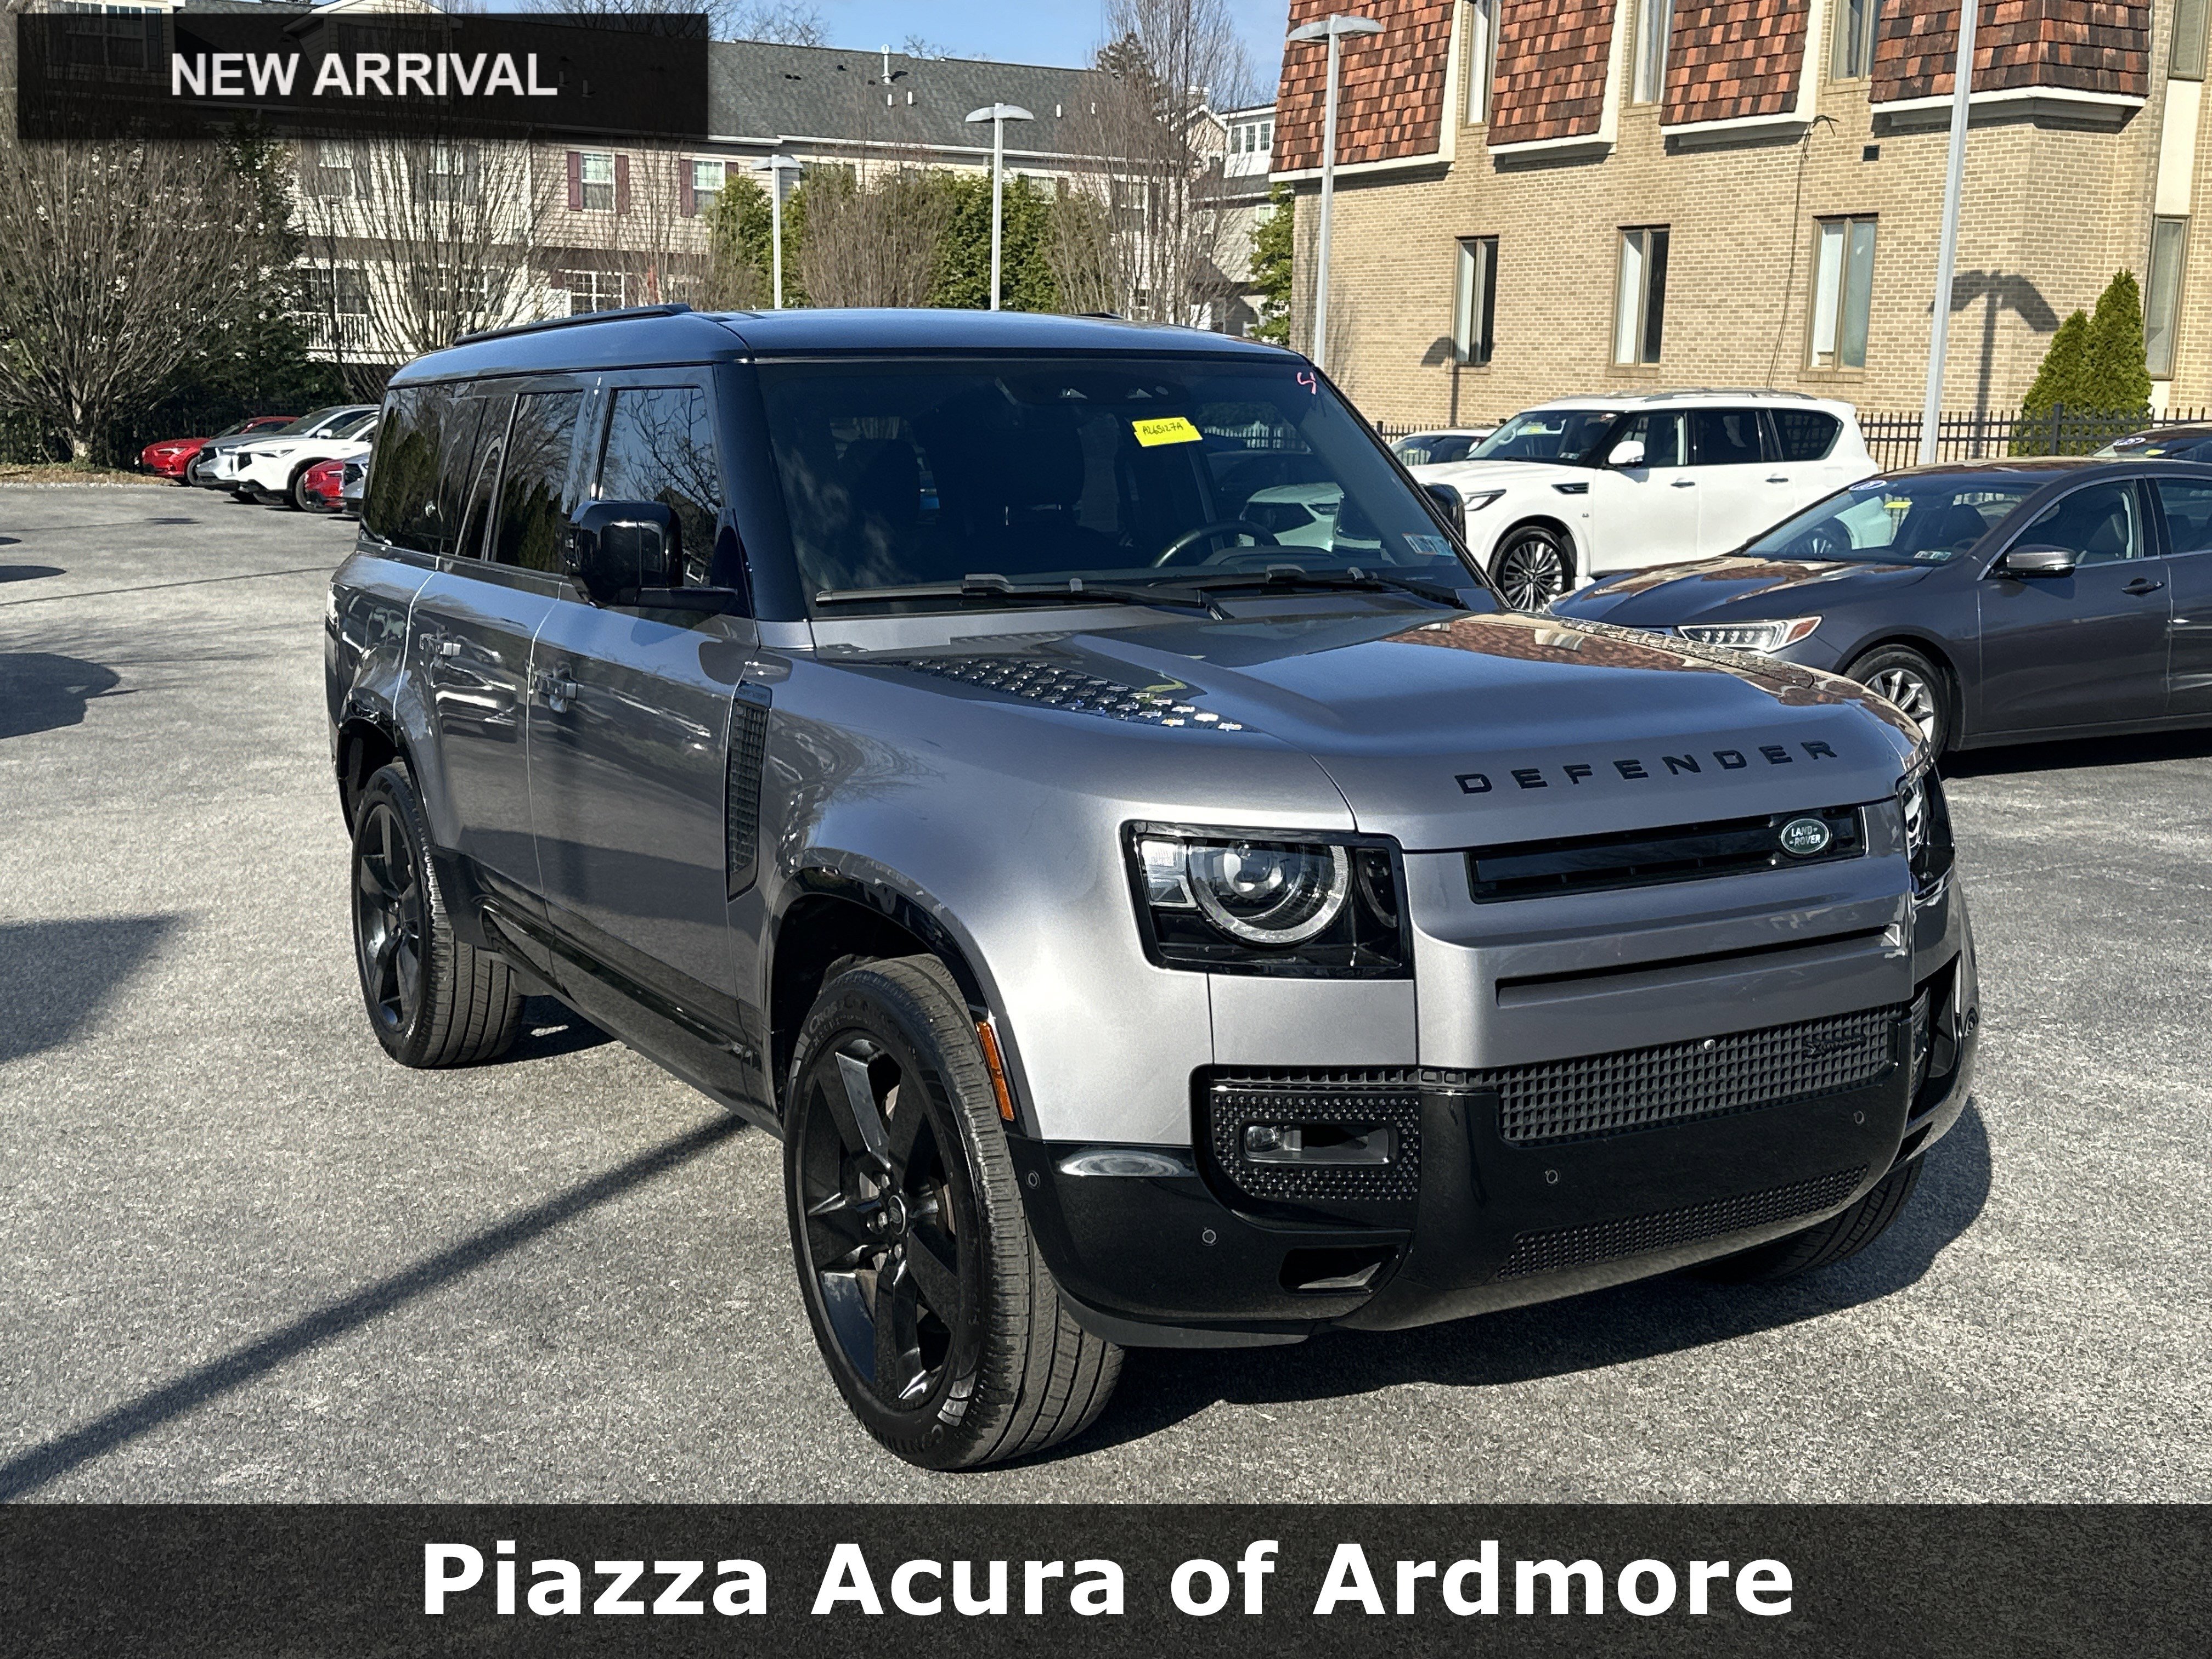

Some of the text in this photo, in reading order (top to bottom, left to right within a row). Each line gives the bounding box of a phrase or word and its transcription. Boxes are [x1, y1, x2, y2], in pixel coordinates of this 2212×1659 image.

[1297, 371, 1316, 395] 4
[1454, 740, 1837, 794] DEFENDER
[1791, 826, 1813, 837] LAND
[1794, 834, 1821, 846] ROVER
